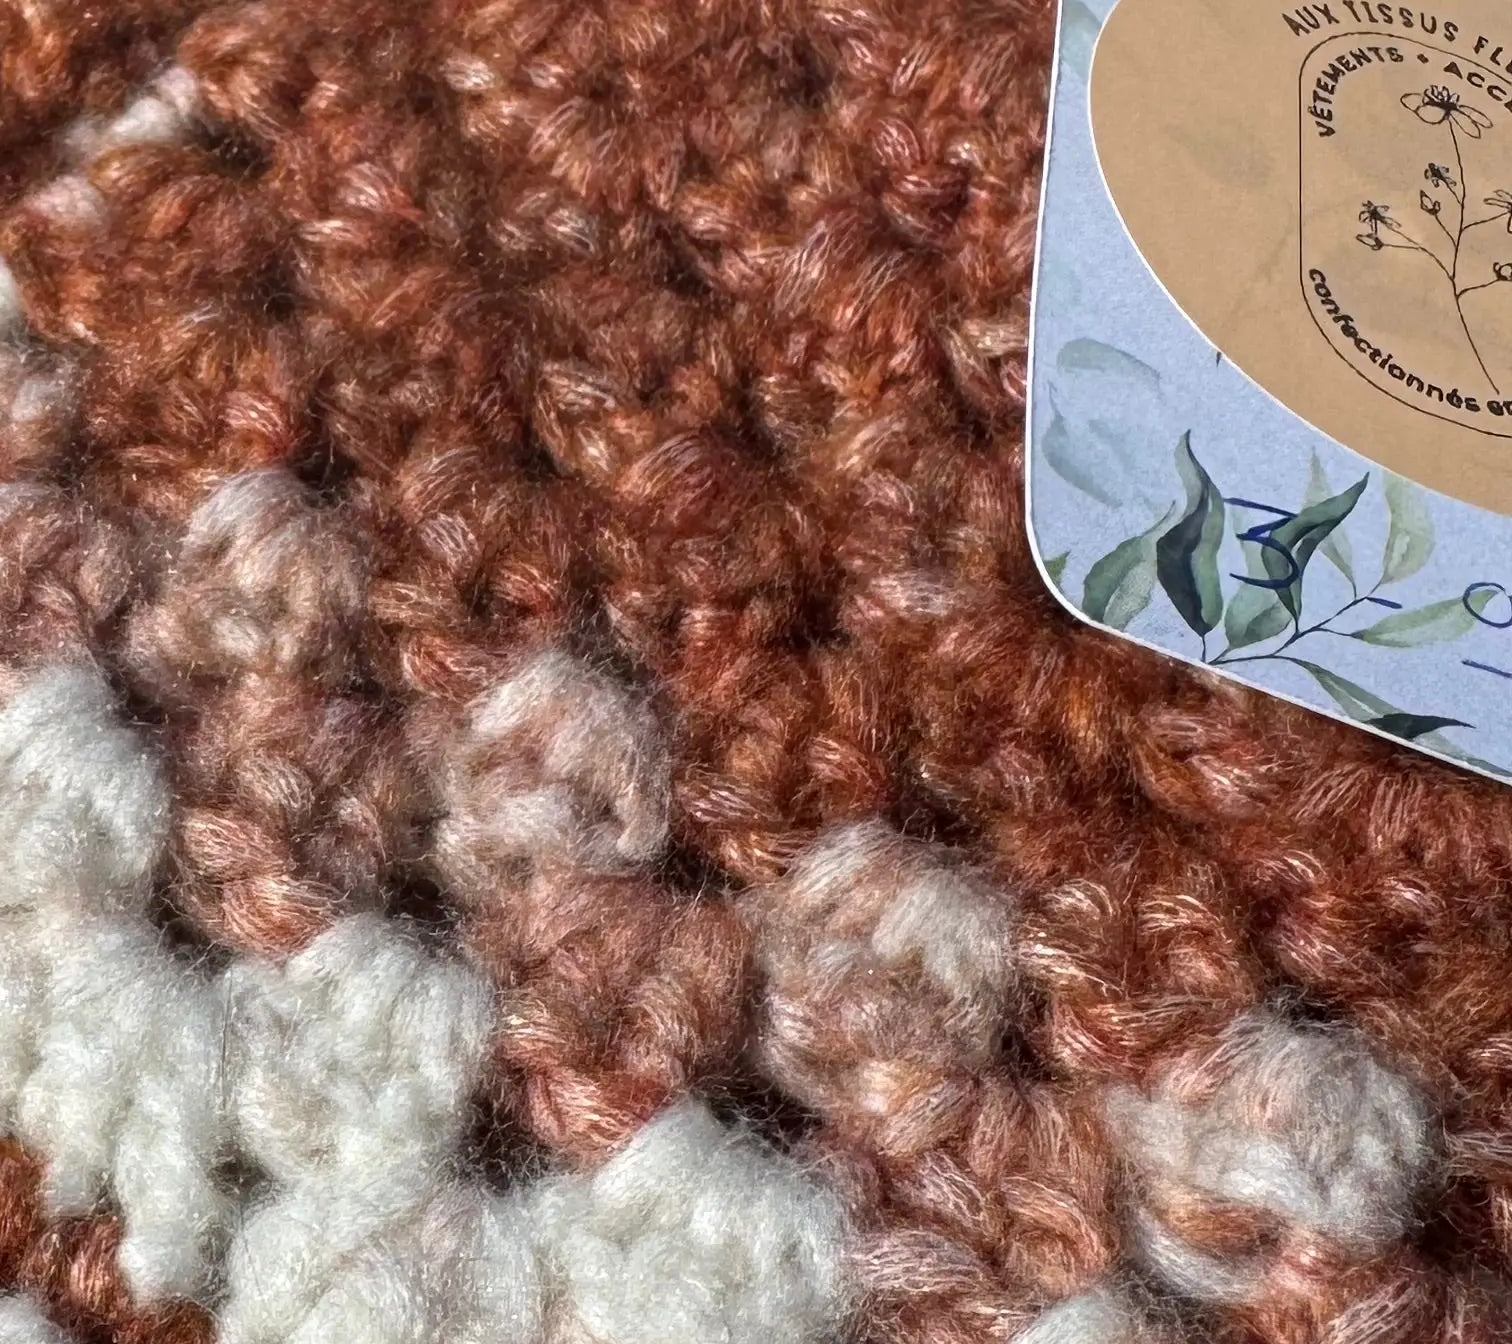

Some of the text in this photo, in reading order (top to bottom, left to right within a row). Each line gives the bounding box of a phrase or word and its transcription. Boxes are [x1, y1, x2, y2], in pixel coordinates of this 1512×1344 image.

[1281, 2, 1340, 37] AUX
[1307, 46, 1404, 138] VÊTEMENTS
[1308, 268, 1481, 413] confectionnés
